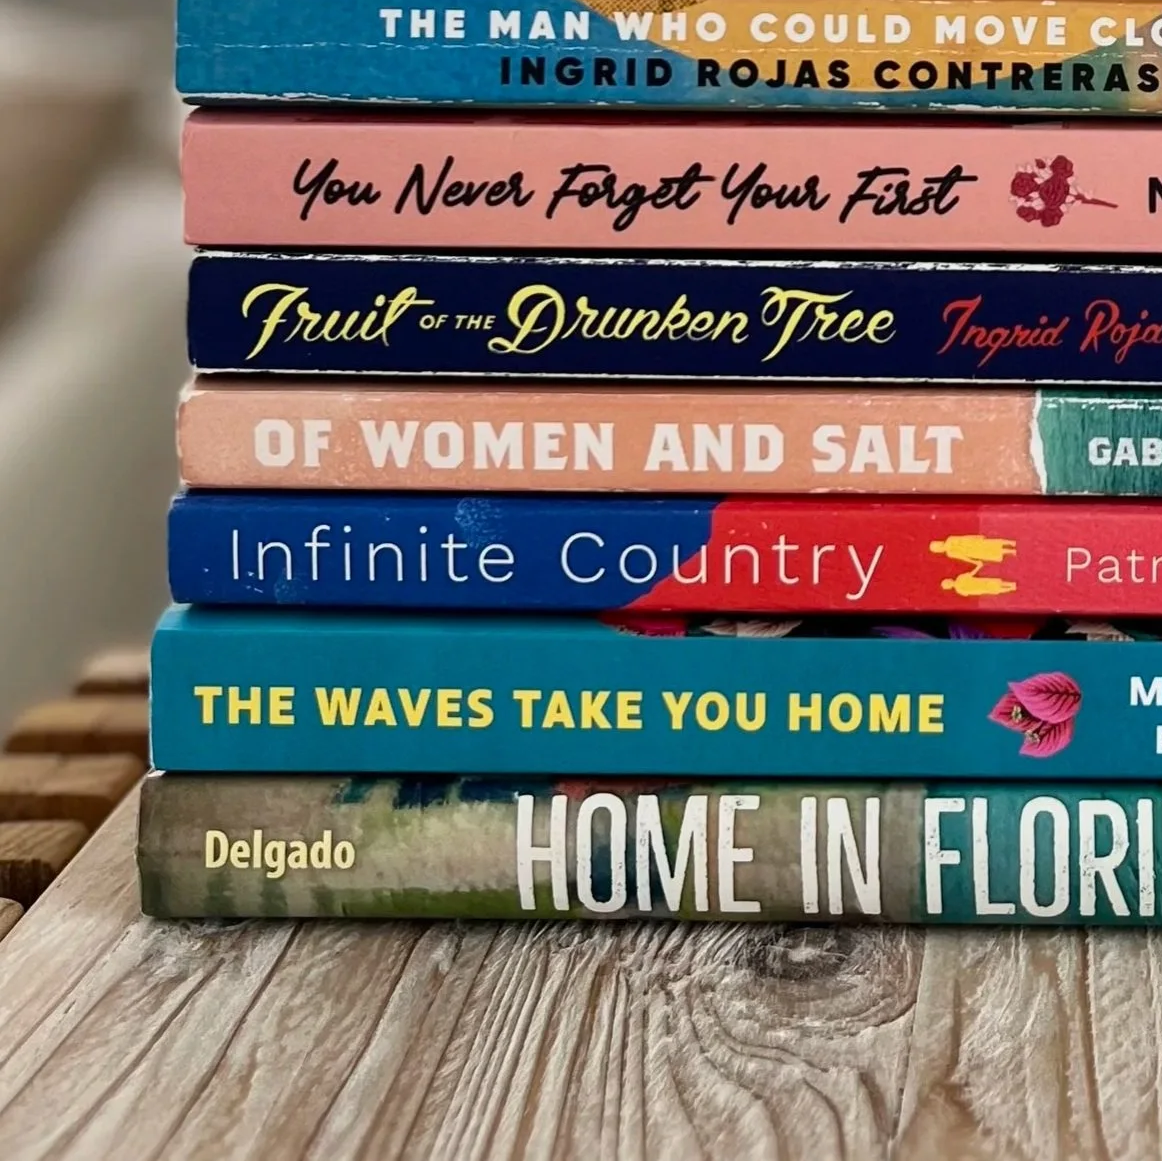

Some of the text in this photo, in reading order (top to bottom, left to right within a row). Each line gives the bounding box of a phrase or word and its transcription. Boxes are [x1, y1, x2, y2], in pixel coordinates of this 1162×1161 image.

[380, 9, 466, 39] THE
[490, 10, 589, 41] MAN
[614, 12, 726, 42] WHO
[757, 12, 911, 46] COULD
[934, 15, 1067, 47] MOVE
[500, 56, 1160, 93] INGRID ROJAS CONTRERAS
[293, 156, 978, 231] You Never Forget Your First
[242, 283, 897, 363] Fruit OF THE Drunken Tree
[936, 294, 1070, 369] Ingrid
[253, 418, 963, 476] OF WOMEN AND SALT
[230, 525, 885, 601] Infinite Country
[194, 685, 945, 734] THE WAVES TAKE YOU HOME
[204, 829, 356, 879] Delgado
[516, 791, 762, 917] HOME
[799, 795, 882, 917] IN
